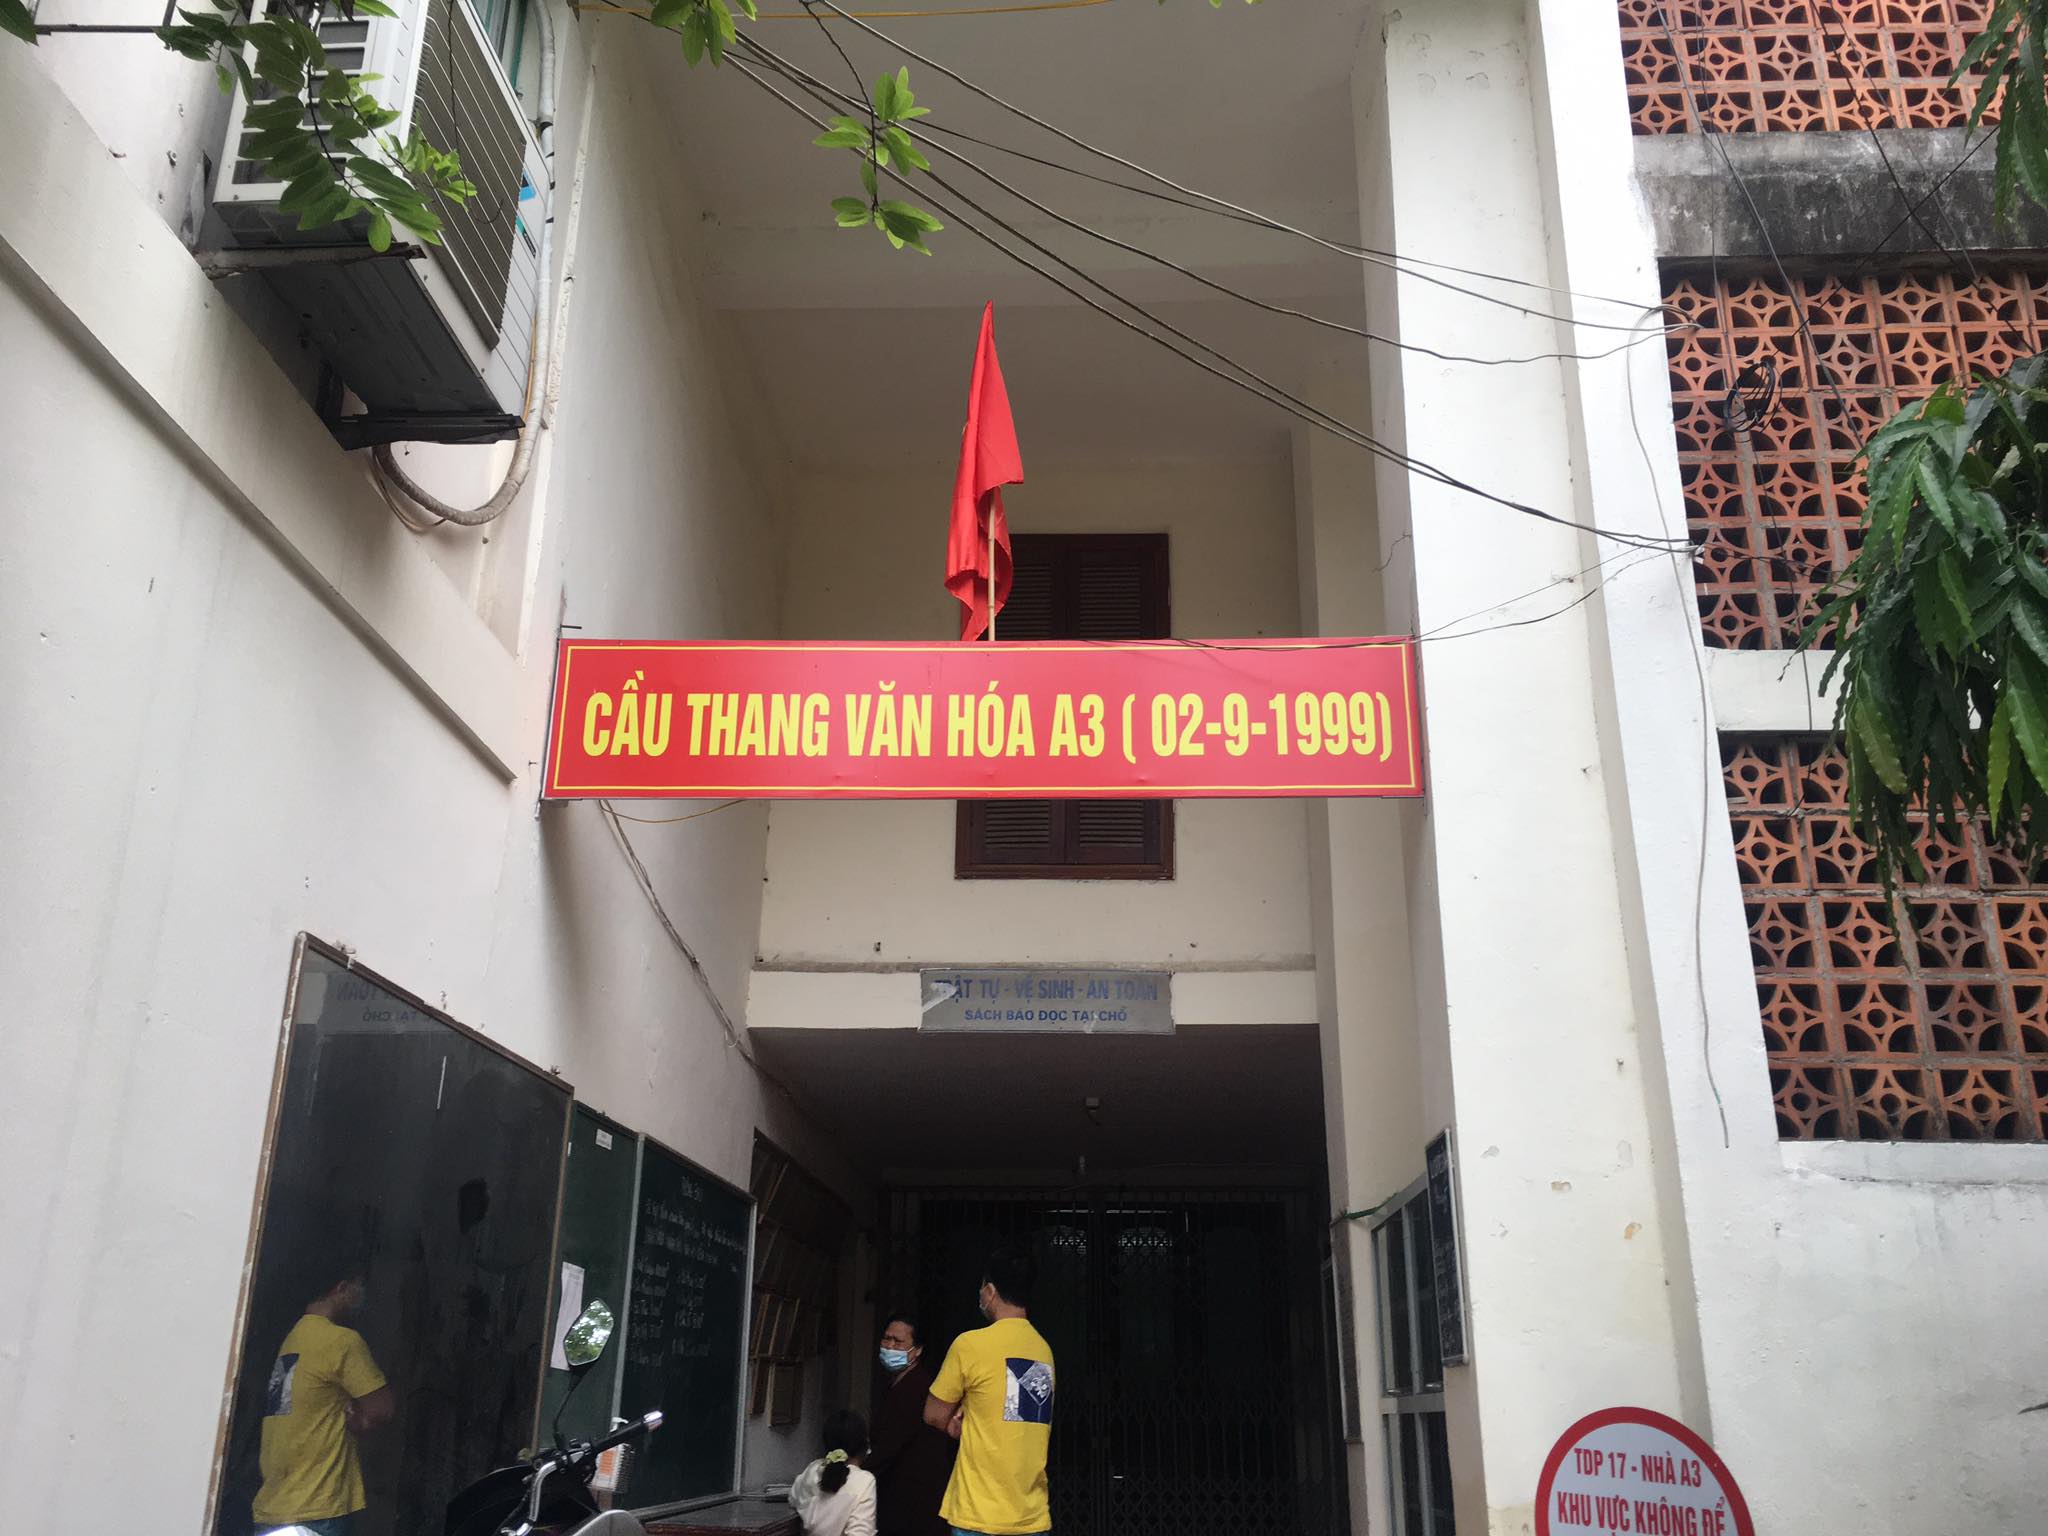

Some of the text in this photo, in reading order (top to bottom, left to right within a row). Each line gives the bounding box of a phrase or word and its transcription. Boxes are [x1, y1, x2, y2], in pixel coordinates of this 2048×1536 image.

[582, 670, 673, 757] CẦU
[686, 693, 831, 757] THANG
[844, 679, 933, 757] VĂN
[946, 679, 1036, 757] HÓA
[1048, 693, 1106, 757] A3
[1038, 979, 1074, 999] SINH
[1038, 1010, 1067, 1024] ĐỌC
[1573, 1448, 1603, 1476] TDP
[1607, 1452, 1626, 1479] 17
[1641, 1450, 1676, 1485] NHÀ
[1680, 1459, 1701, 1487] A3
[1557, 1491, 1592, 1527] KHU
[1595, 1494, 1630, 1536] VỰC
[1634, 1496, 1698, 1536] KHÔNG
